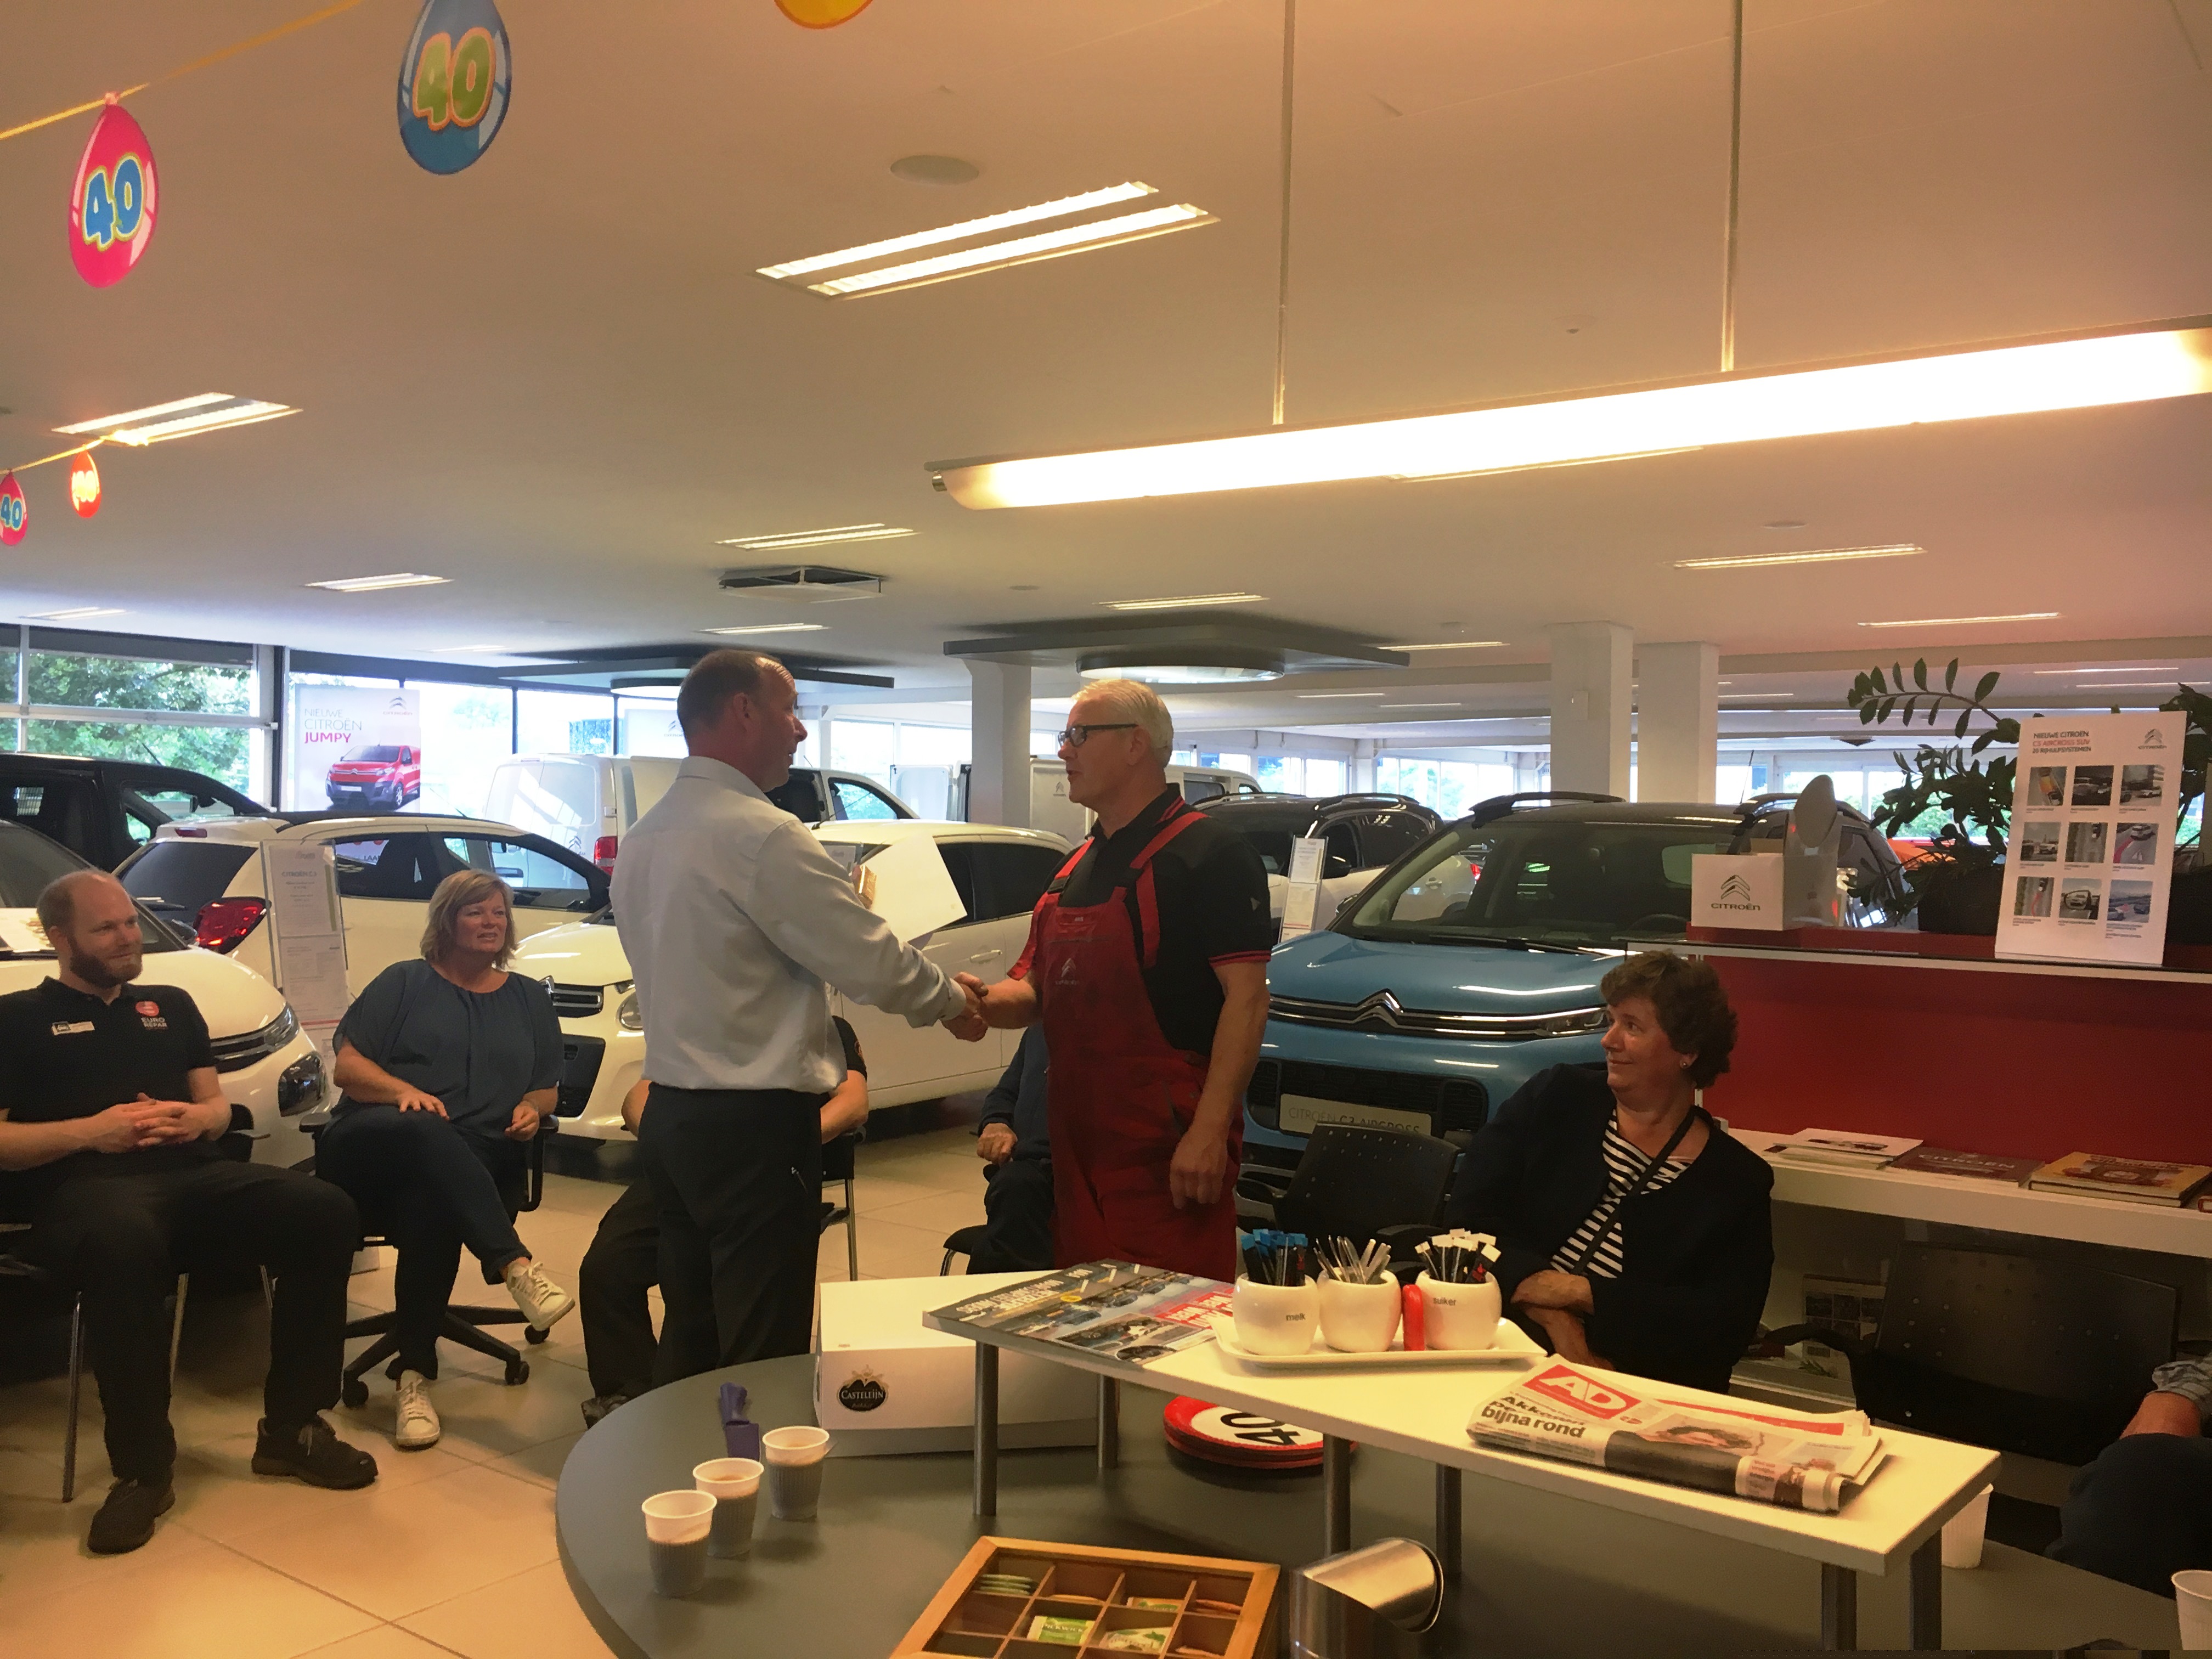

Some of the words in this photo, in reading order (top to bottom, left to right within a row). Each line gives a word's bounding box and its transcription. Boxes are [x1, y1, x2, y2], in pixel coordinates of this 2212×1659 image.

[413, 27, 496, 131] 40
[83, 153, 144, 251] 40
[0, 494, 23, 531] 40
[304, 708, 343, 718] NIEUWE
[304, 718, 362, 731] CITROËN
[304, 732, 352, 744] JUMPY
[1711, 902, 1761, 911] CITROËN
[1432, 1296, 1457, 1306] suiker
[1285, 1312, 1306, 1322] melk
[1538, 1375, 1627, 1410] AD
[1220, 1412, 1301, 1446] 40
[1481, 1406, 1531, 1424] bijna
[1533, 1419, 1587, 1438] rond
